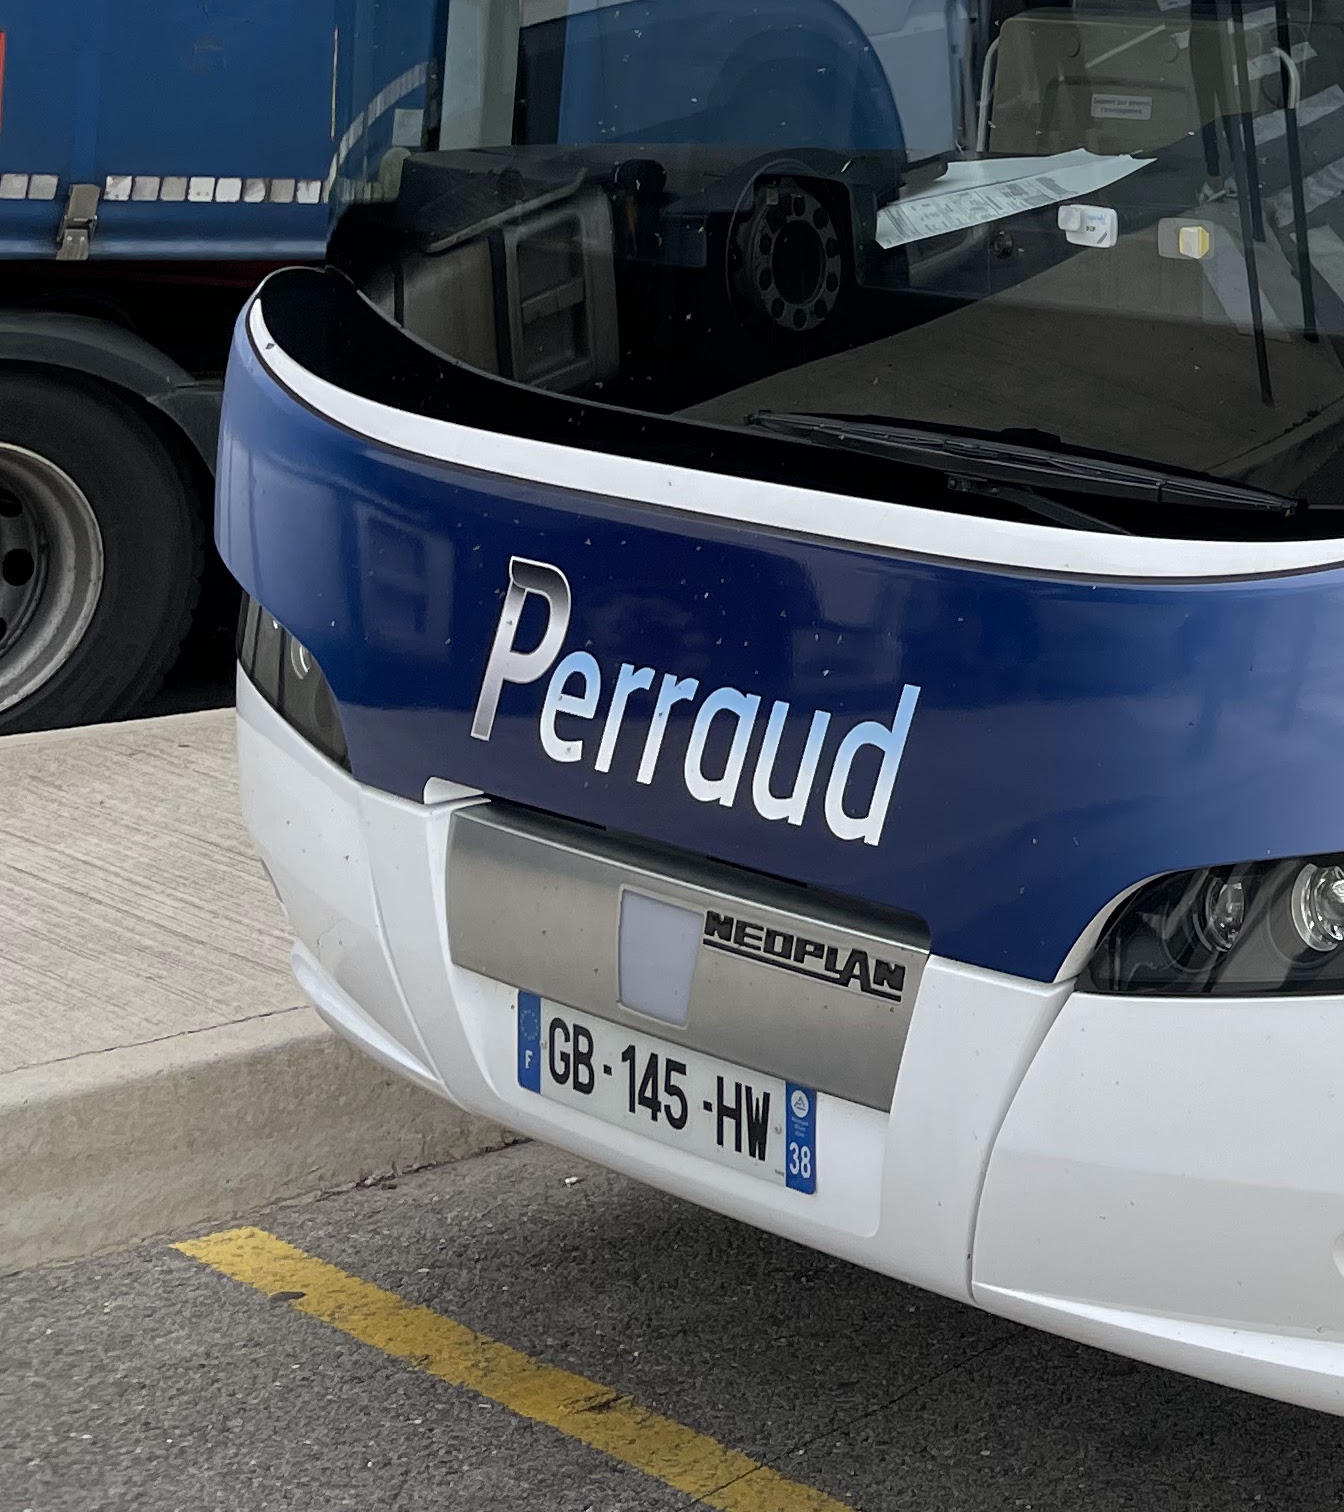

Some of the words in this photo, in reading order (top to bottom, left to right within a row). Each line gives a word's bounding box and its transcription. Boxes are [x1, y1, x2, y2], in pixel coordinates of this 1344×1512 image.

[469, 555, 921, 847] Perraud
[703, 909, 907, 1003] NEOPLAN
[524, 1048, 534, 1070] F
[788, 1140, 812, 1180] 38
